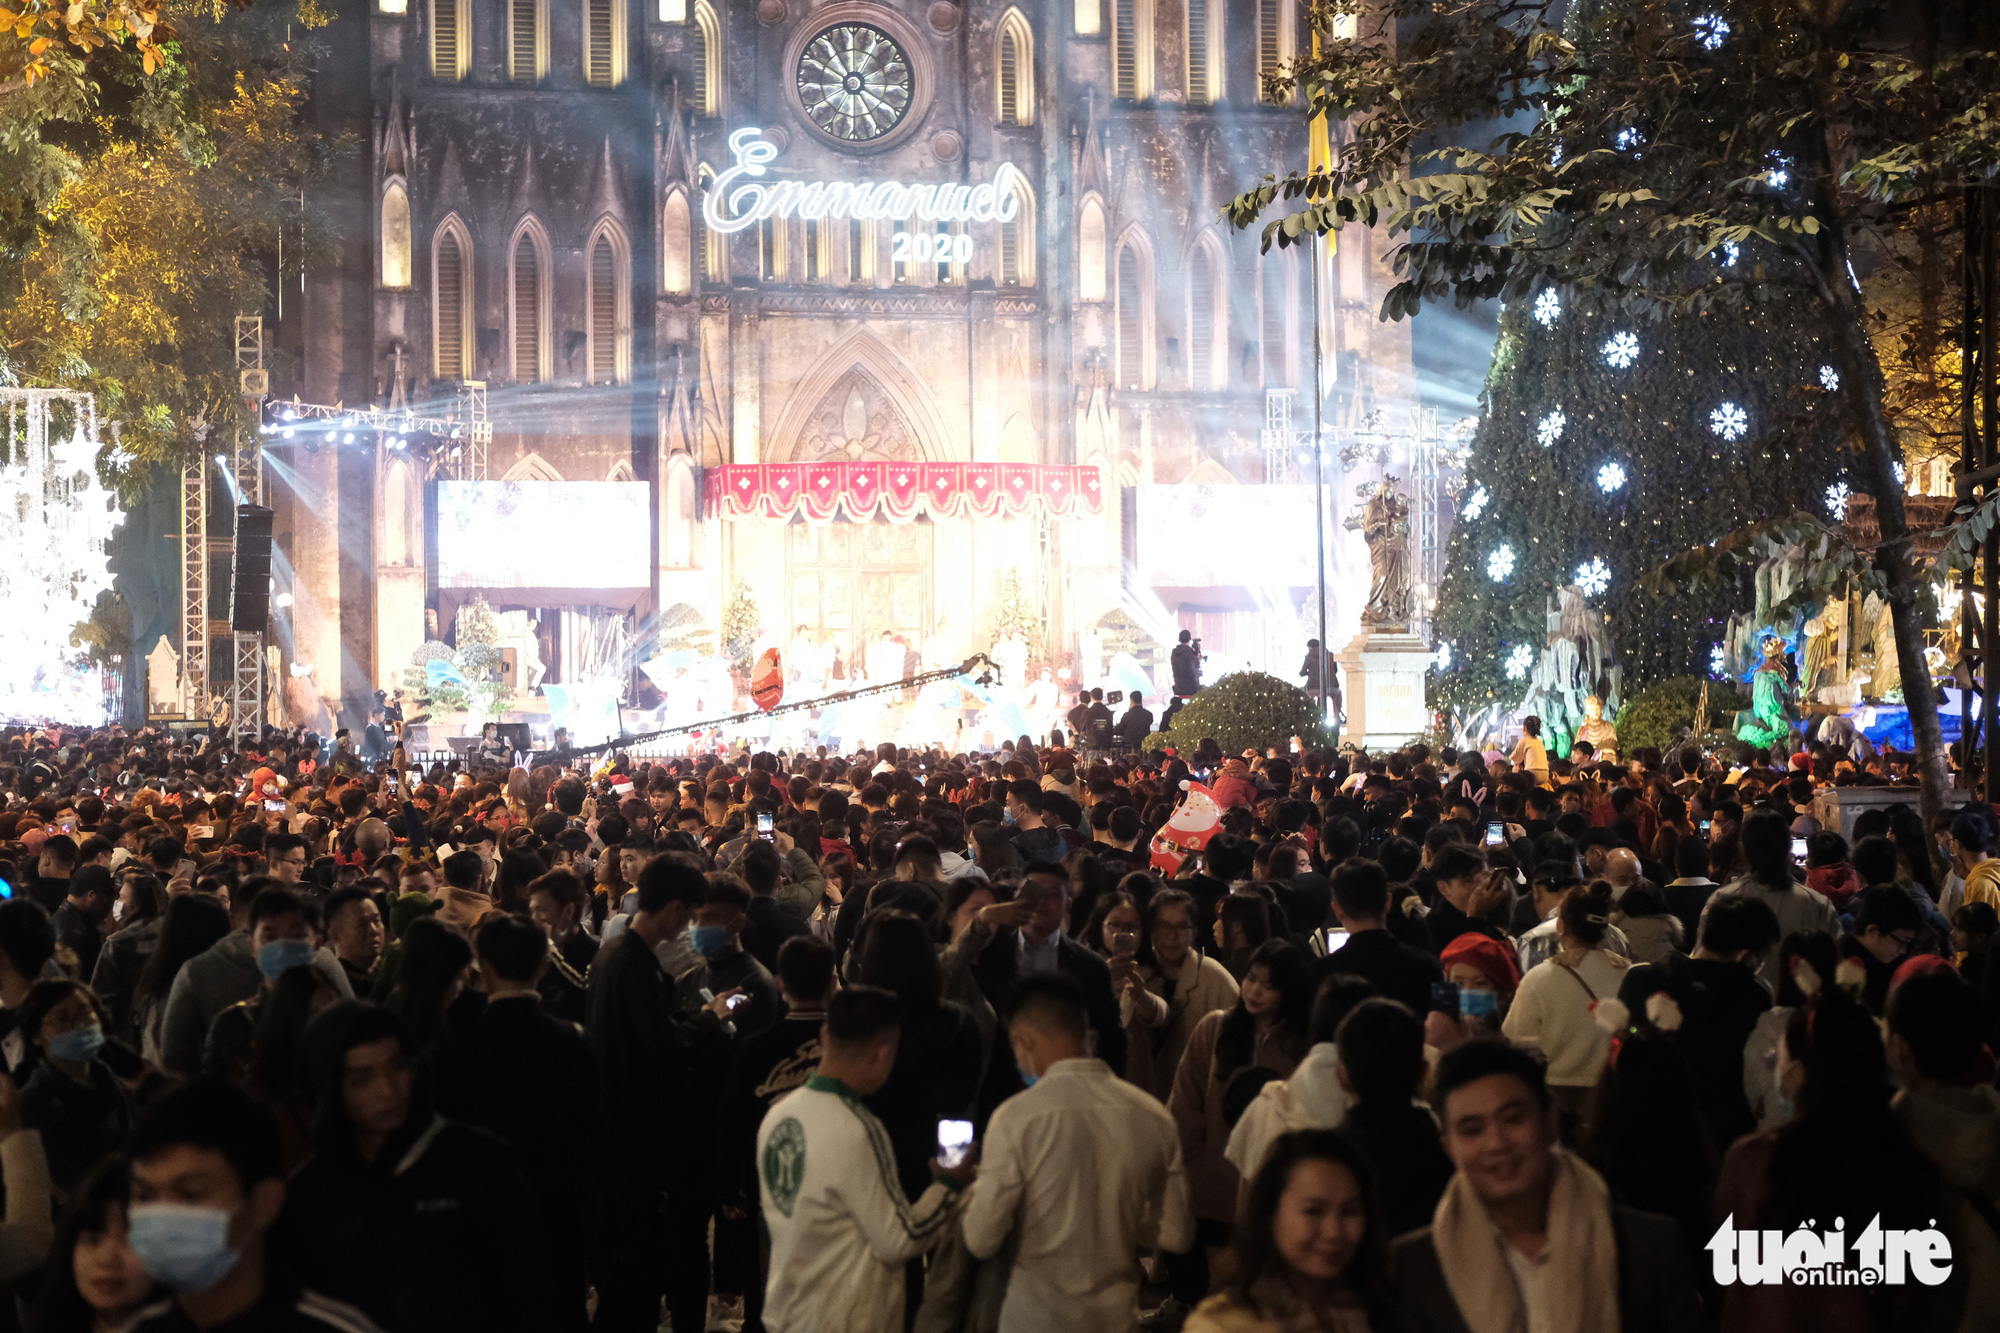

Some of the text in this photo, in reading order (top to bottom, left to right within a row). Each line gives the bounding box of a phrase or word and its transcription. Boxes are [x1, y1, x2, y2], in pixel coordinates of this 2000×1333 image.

[703, 127, 1018, 233] Emmanuel
[891, 232, 974, 264] 2020
[1377, 684, 1413, 697] REGINA
